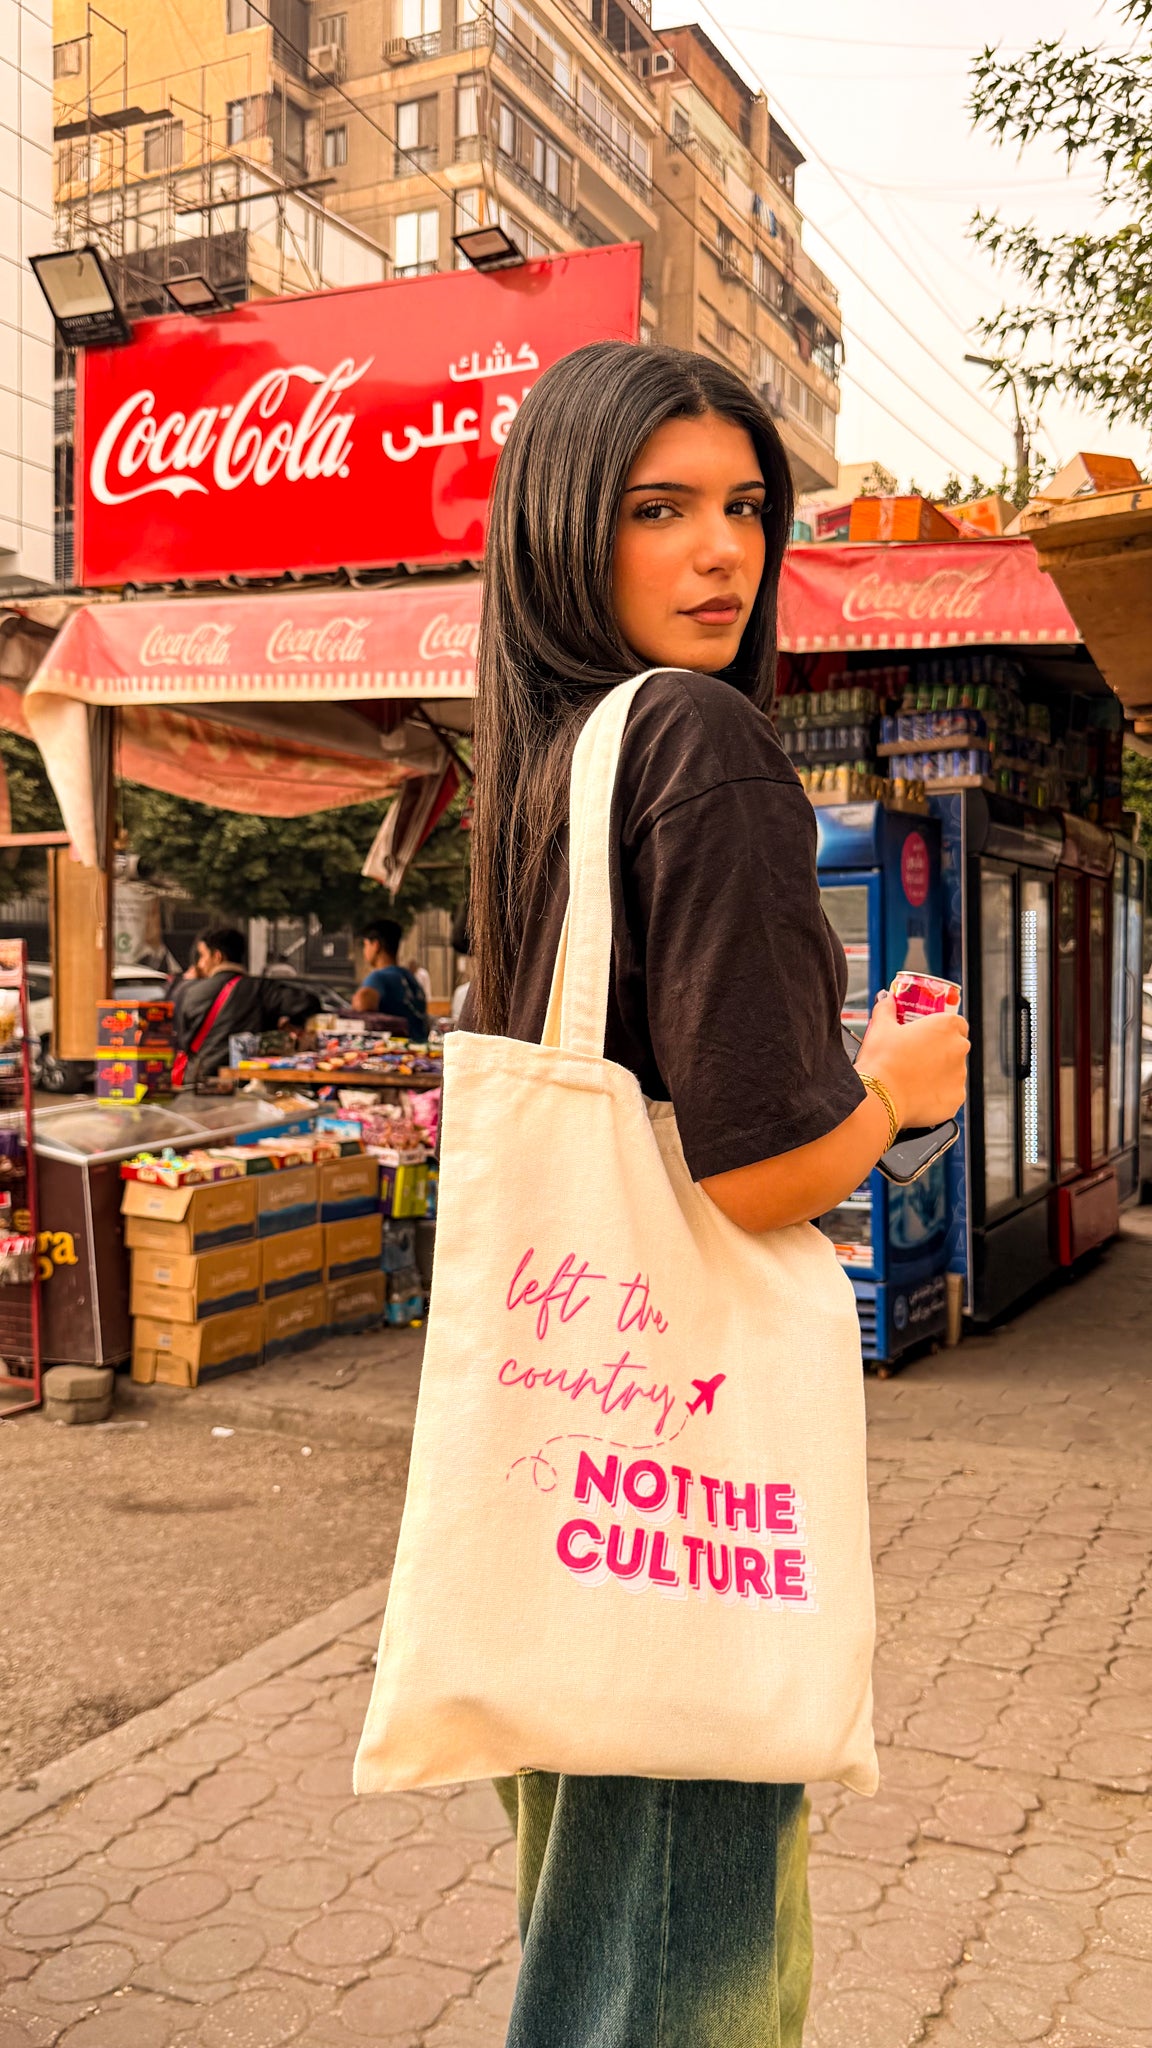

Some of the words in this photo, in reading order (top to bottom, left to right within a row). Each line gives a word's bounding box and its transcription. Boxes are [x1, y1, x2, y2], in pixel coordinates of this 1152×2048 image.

[449, 341, 540, 383] كشك
[90, 356, 376, 506] Coca-Cola
[382, 401, 480, 463] على
[507, 1247, 607, 1340] left
[617, 1271, 669, 1334] the
[498, 1350, 676, 1436] country
[573, 1450, 695, 1521] NOT
[700, 1474, 800, 1535] THE
[556, 1518, 808, 1601] CULTURE
